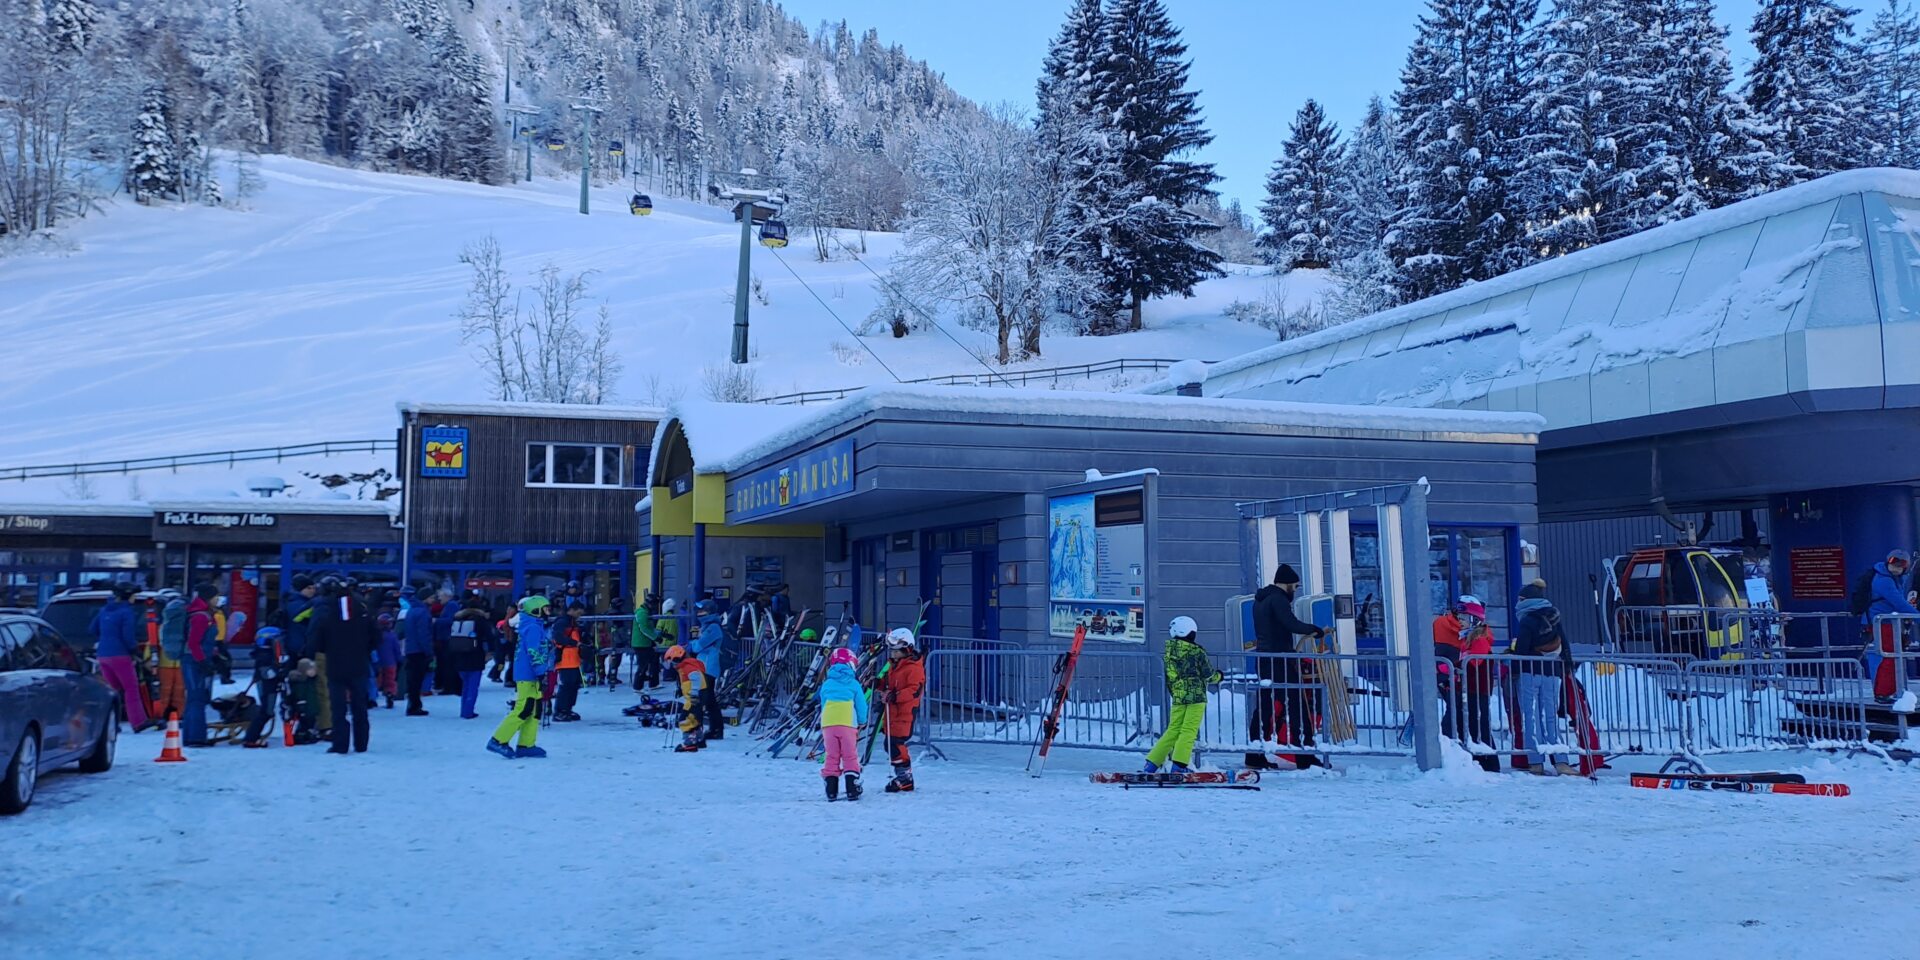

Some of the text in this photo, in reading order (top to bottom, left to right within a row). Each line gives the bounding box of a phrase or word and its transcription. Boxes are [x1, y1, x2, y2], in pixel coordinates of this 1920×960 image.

[737, 453, 849, 513] GRÜSCH DANUSA
[15, 515, 48, 530] Shop
[249, 514, 274, 525] Info
